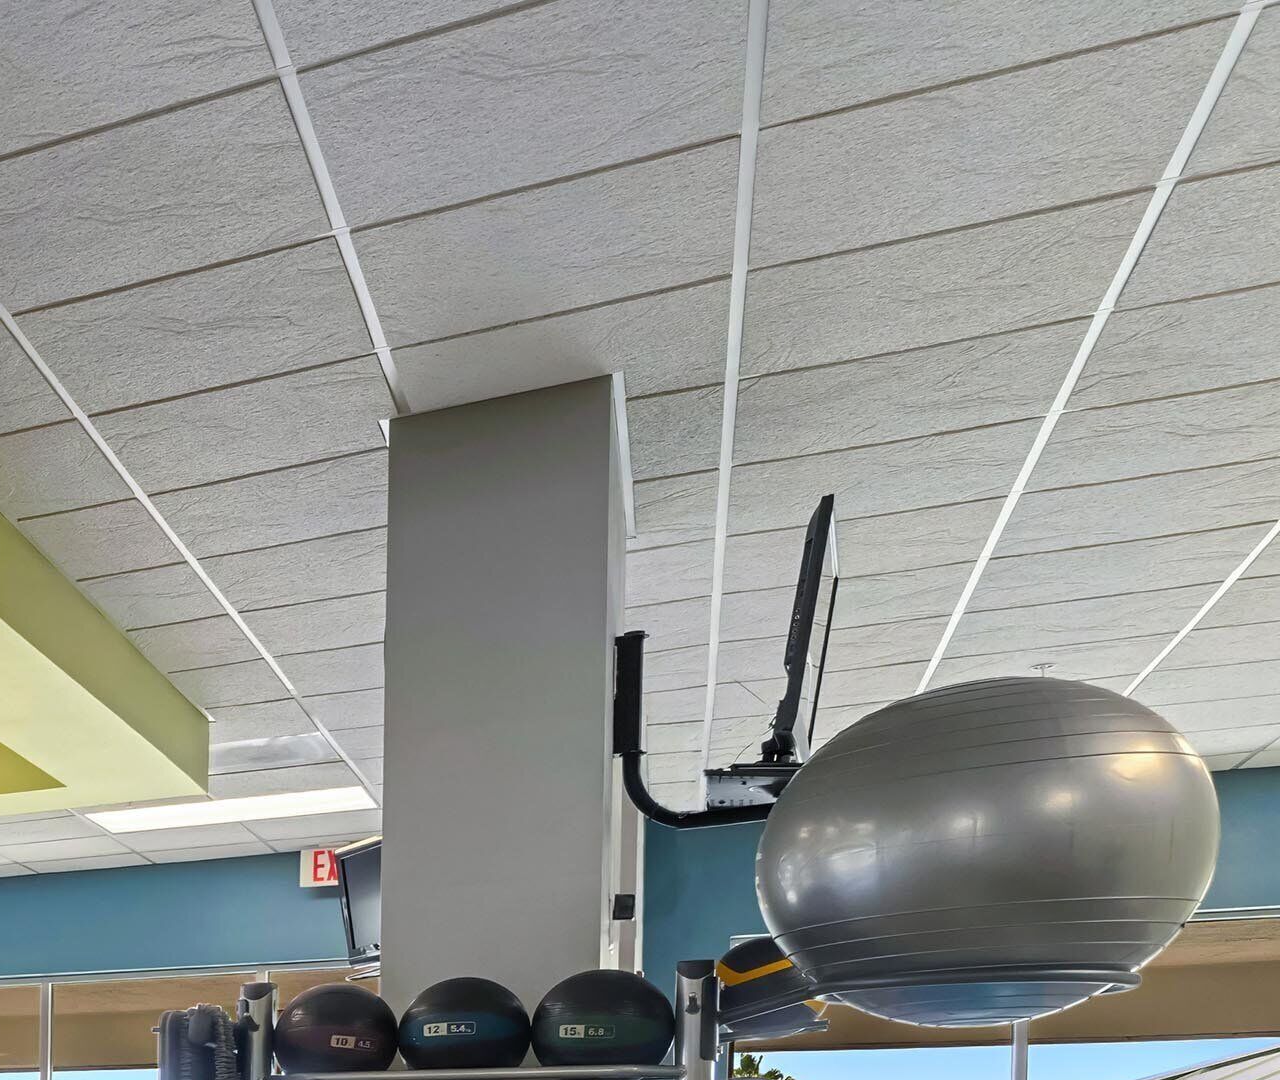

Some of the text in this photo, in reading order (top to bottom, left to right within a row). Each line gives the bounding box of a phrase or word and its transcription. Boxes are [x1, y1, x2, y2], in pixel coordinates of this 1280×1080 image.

[426, 1025, 440, 1034] 12
[450, 1024, 466, 1033] 5.4
[563, 1026, 605, 1036] 15 6.8
[336, 1037, 348, 1046] 10
